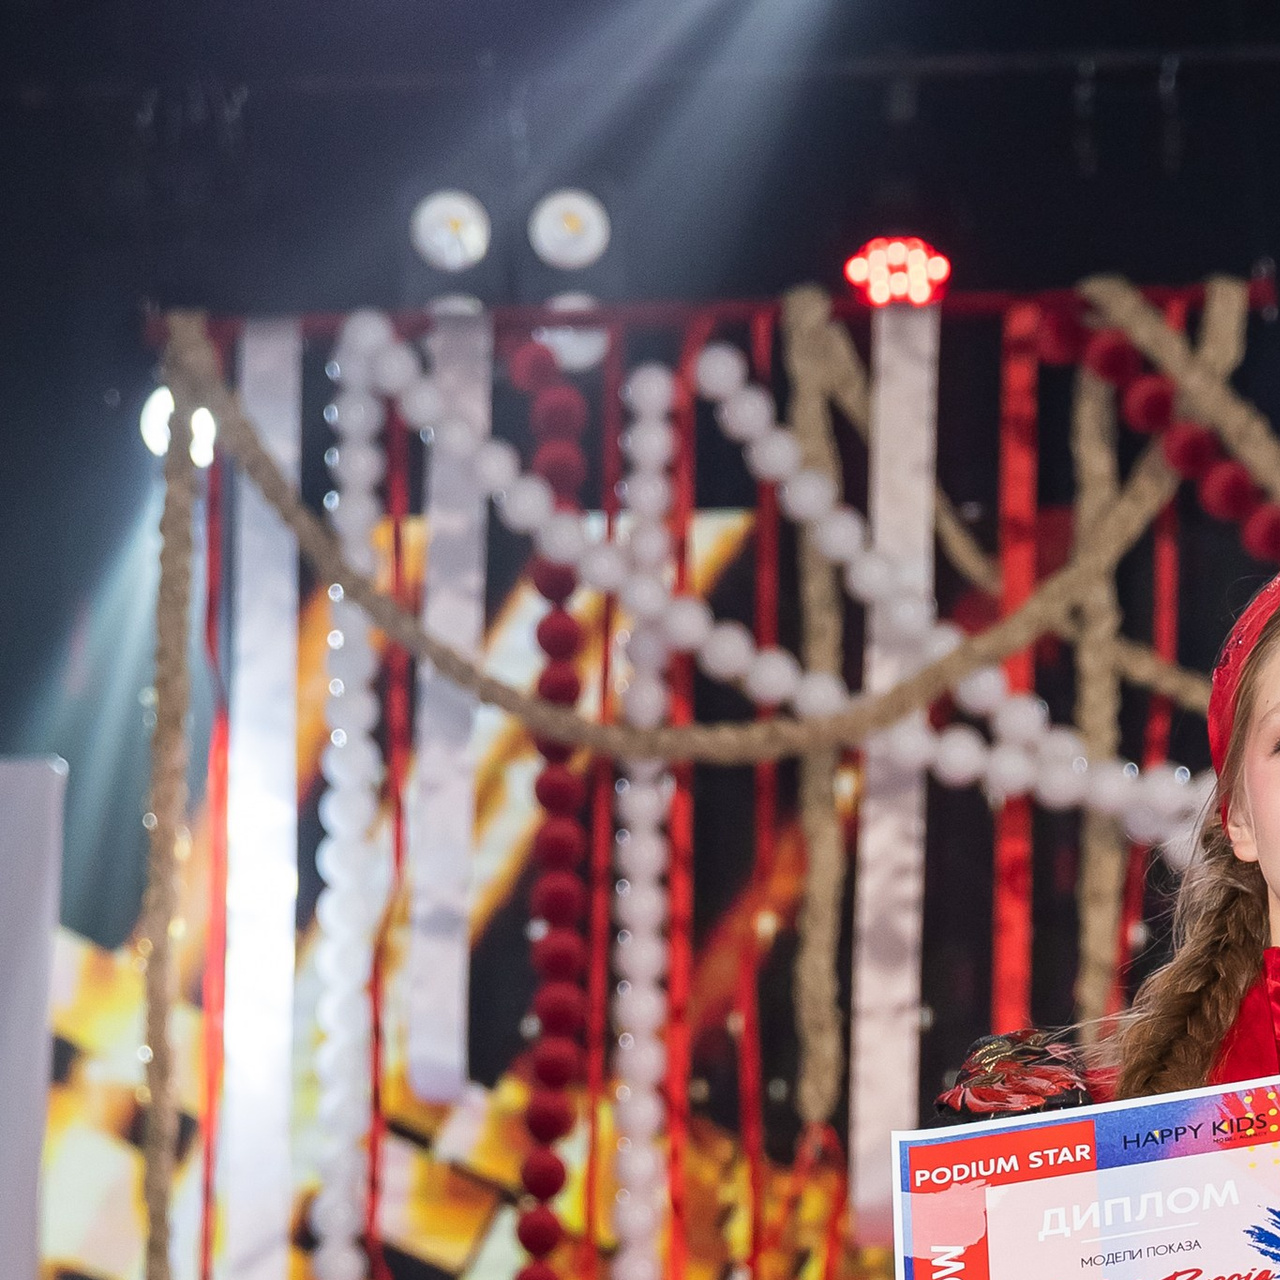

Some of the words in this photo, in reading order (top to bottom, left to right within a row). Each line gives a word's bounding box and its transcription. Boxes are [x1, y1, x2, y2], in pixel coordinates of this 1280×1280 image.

[1122, 1123, 1204, 1151] HAPPY
[1212, 1113, 1268, 1136] KIDS
[914, 1155, 1020, 1188] PODIUM
[1028, 1143, 1092, 1169] STAR
[1037, 1180, 1240, 1243] ДИПЛОМ
[1080, 1247, 1144, 1268] МОДЕЛИ
[1146, 1239, 1203, 1258] ПОКАЗА
